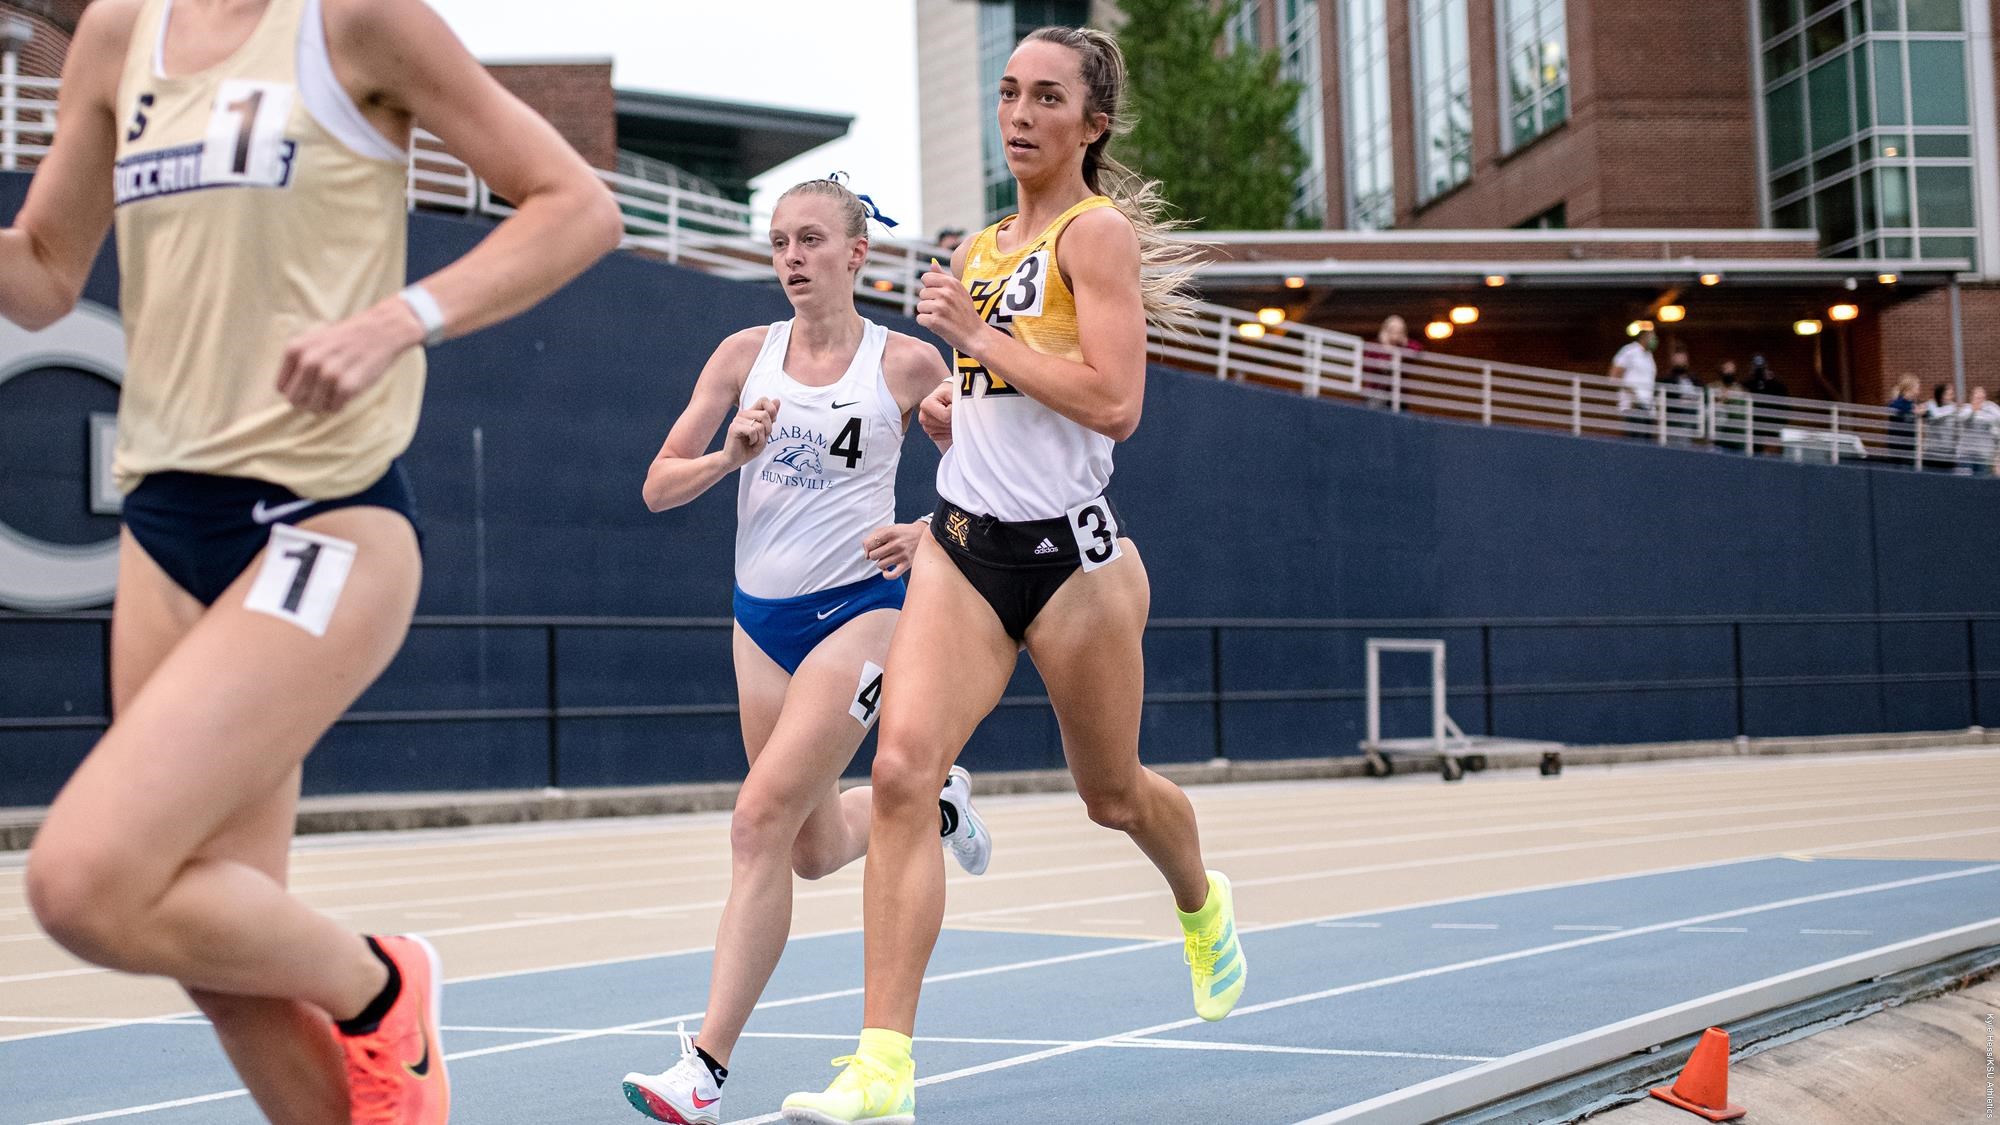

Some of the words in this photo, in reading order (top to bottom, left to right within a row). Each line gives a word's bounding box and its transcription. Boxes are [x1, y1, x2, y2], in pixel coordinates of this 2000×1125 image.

[227, 89, 264, 174] 1
[1006, 257, 1040, 312] 3
[766, 425, 828, 450] LABAM
[829, 417, 863, 469] 4
[1032, 544, 1059, 555] adidas
[1078, 504, 1113, 563] 3
[282, 542, 322, 614] 1
[857, 672, 883, 721] 4
